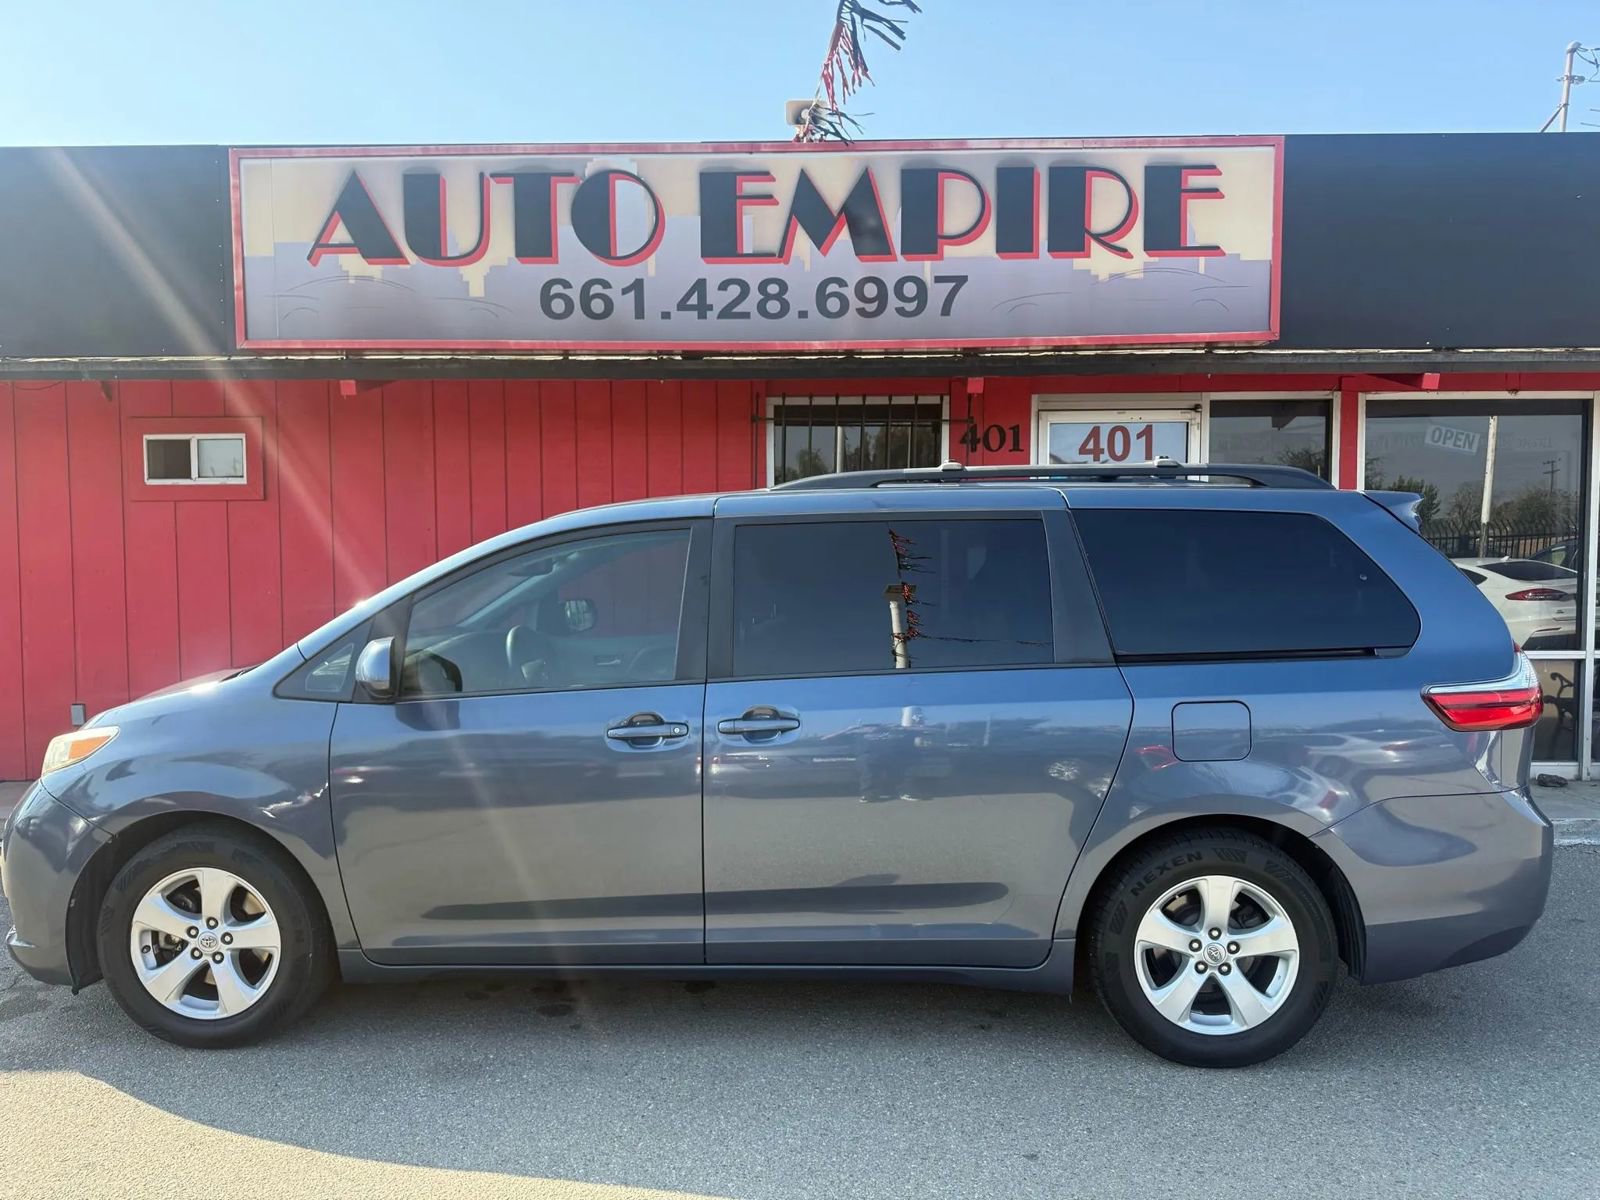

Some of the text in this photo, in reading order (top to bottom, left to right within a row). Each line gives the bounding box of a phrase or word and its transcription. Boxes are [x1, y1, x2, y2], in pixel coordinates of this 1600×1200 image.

[307, 165, 1225, 267] AUTO EMPIRE
[540, 275, 968, 320] 661.428.6997
[960, 424, 1024, 453] 401
[1078, 424, 1153, 462] 401
[1431, 427, 1475, 449] OPEN
[1131, 851, 1202, 896] NEXEN
